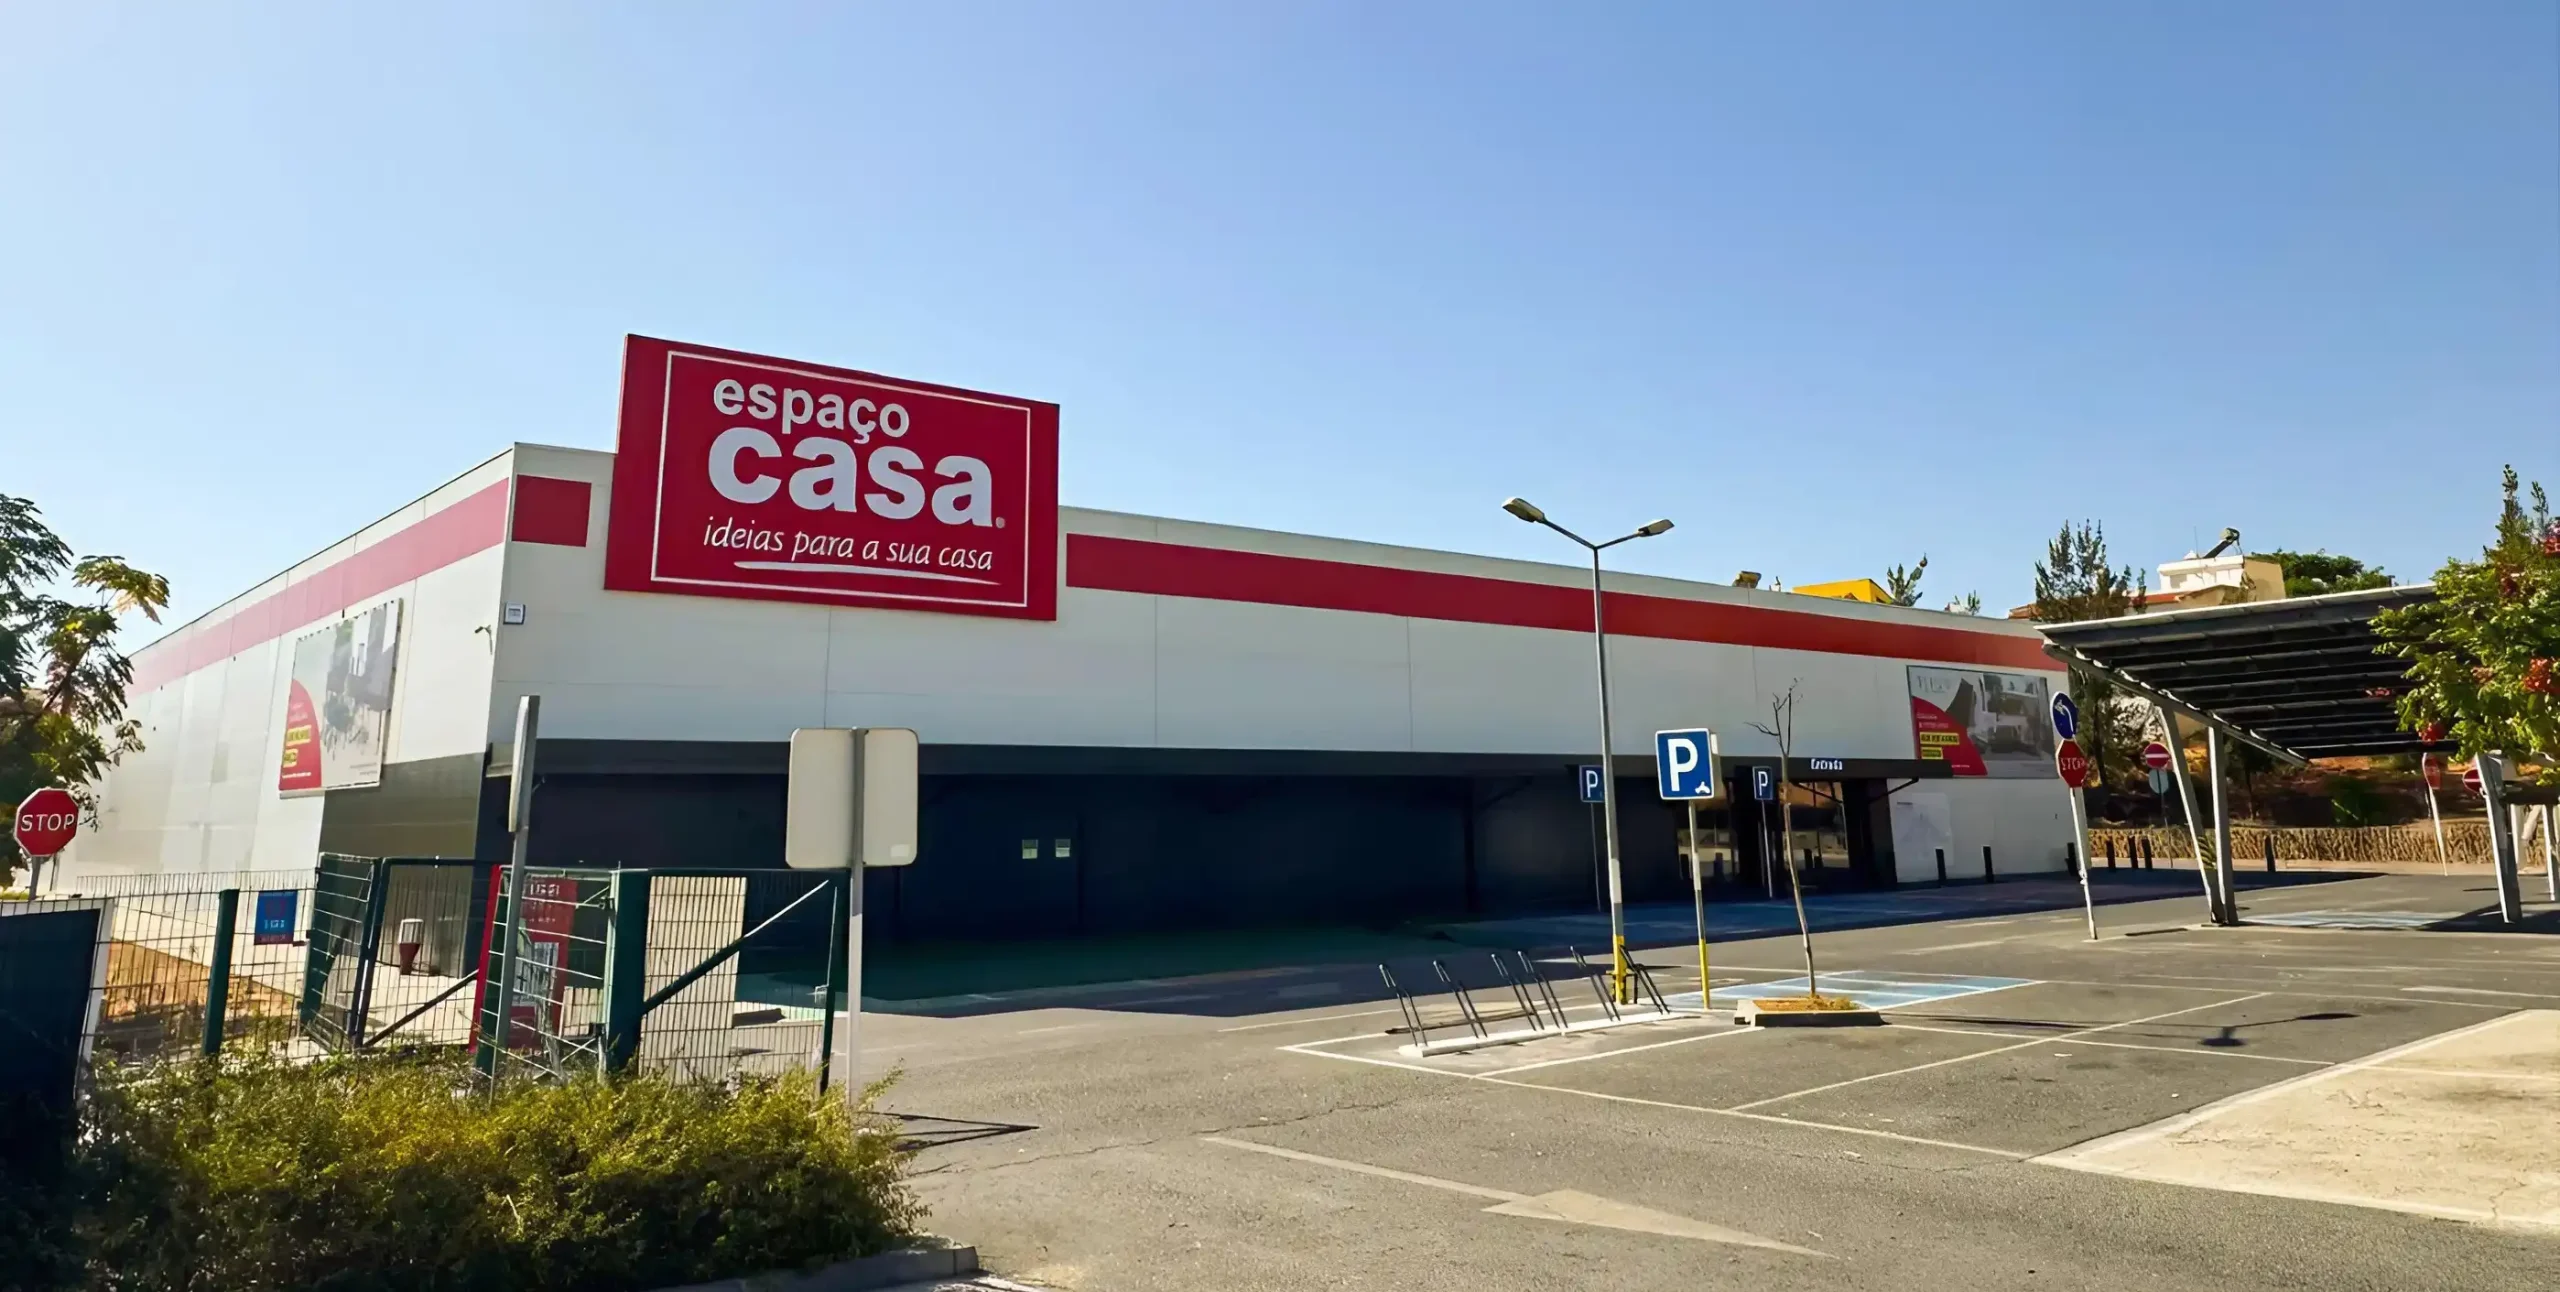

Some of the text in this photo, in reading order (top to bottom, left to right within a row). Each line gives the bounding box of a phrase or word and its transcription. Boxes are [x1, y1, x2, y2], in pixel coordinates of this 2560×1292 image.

[713, 378, 910, 445] espaço
[703, 515, 993, 571] ideias para a sua casa
[1585, 769, 1599, 798] P
[1667, 738, 1698, 792] P
[1757, 770, 1769, 797] P
[20, 813, 76, 832] STOP
